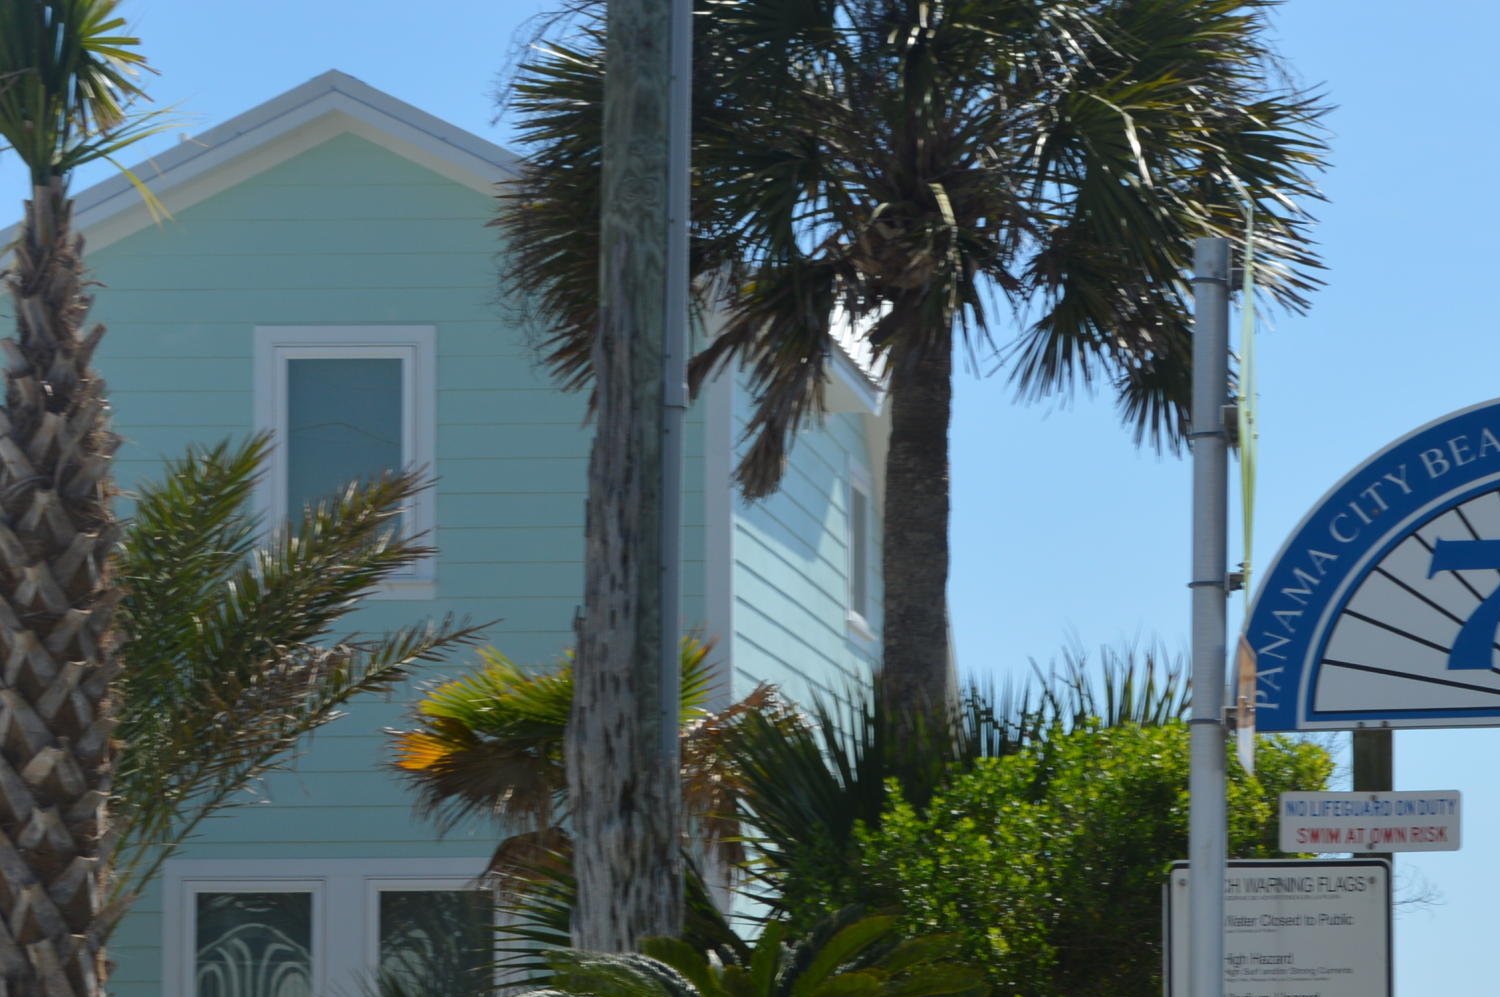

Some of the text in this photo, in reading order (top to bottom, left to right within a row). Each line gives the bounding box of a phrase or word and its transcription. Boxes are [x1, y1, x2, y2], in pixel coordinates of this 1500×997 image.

[1256, 549, 1339, 709] PANAMA
[1329, 464, 1413, 543] CITY
[1285, 799, 1457, 817] NO LIFEGUARD ON DUTY
[1296, 826, 1449, 844] SWIM AT OWN RISK
[1243, 877, 1314, 893] WARNING
[1318, 876, 1367, 893] FLAGS
[1259, 914, 1300, 927] Closed
[1304, 914, 1315, 926] to
[1319, 912, 1354, 926] Public
[1249, 952, 1295, 965] Hazard
